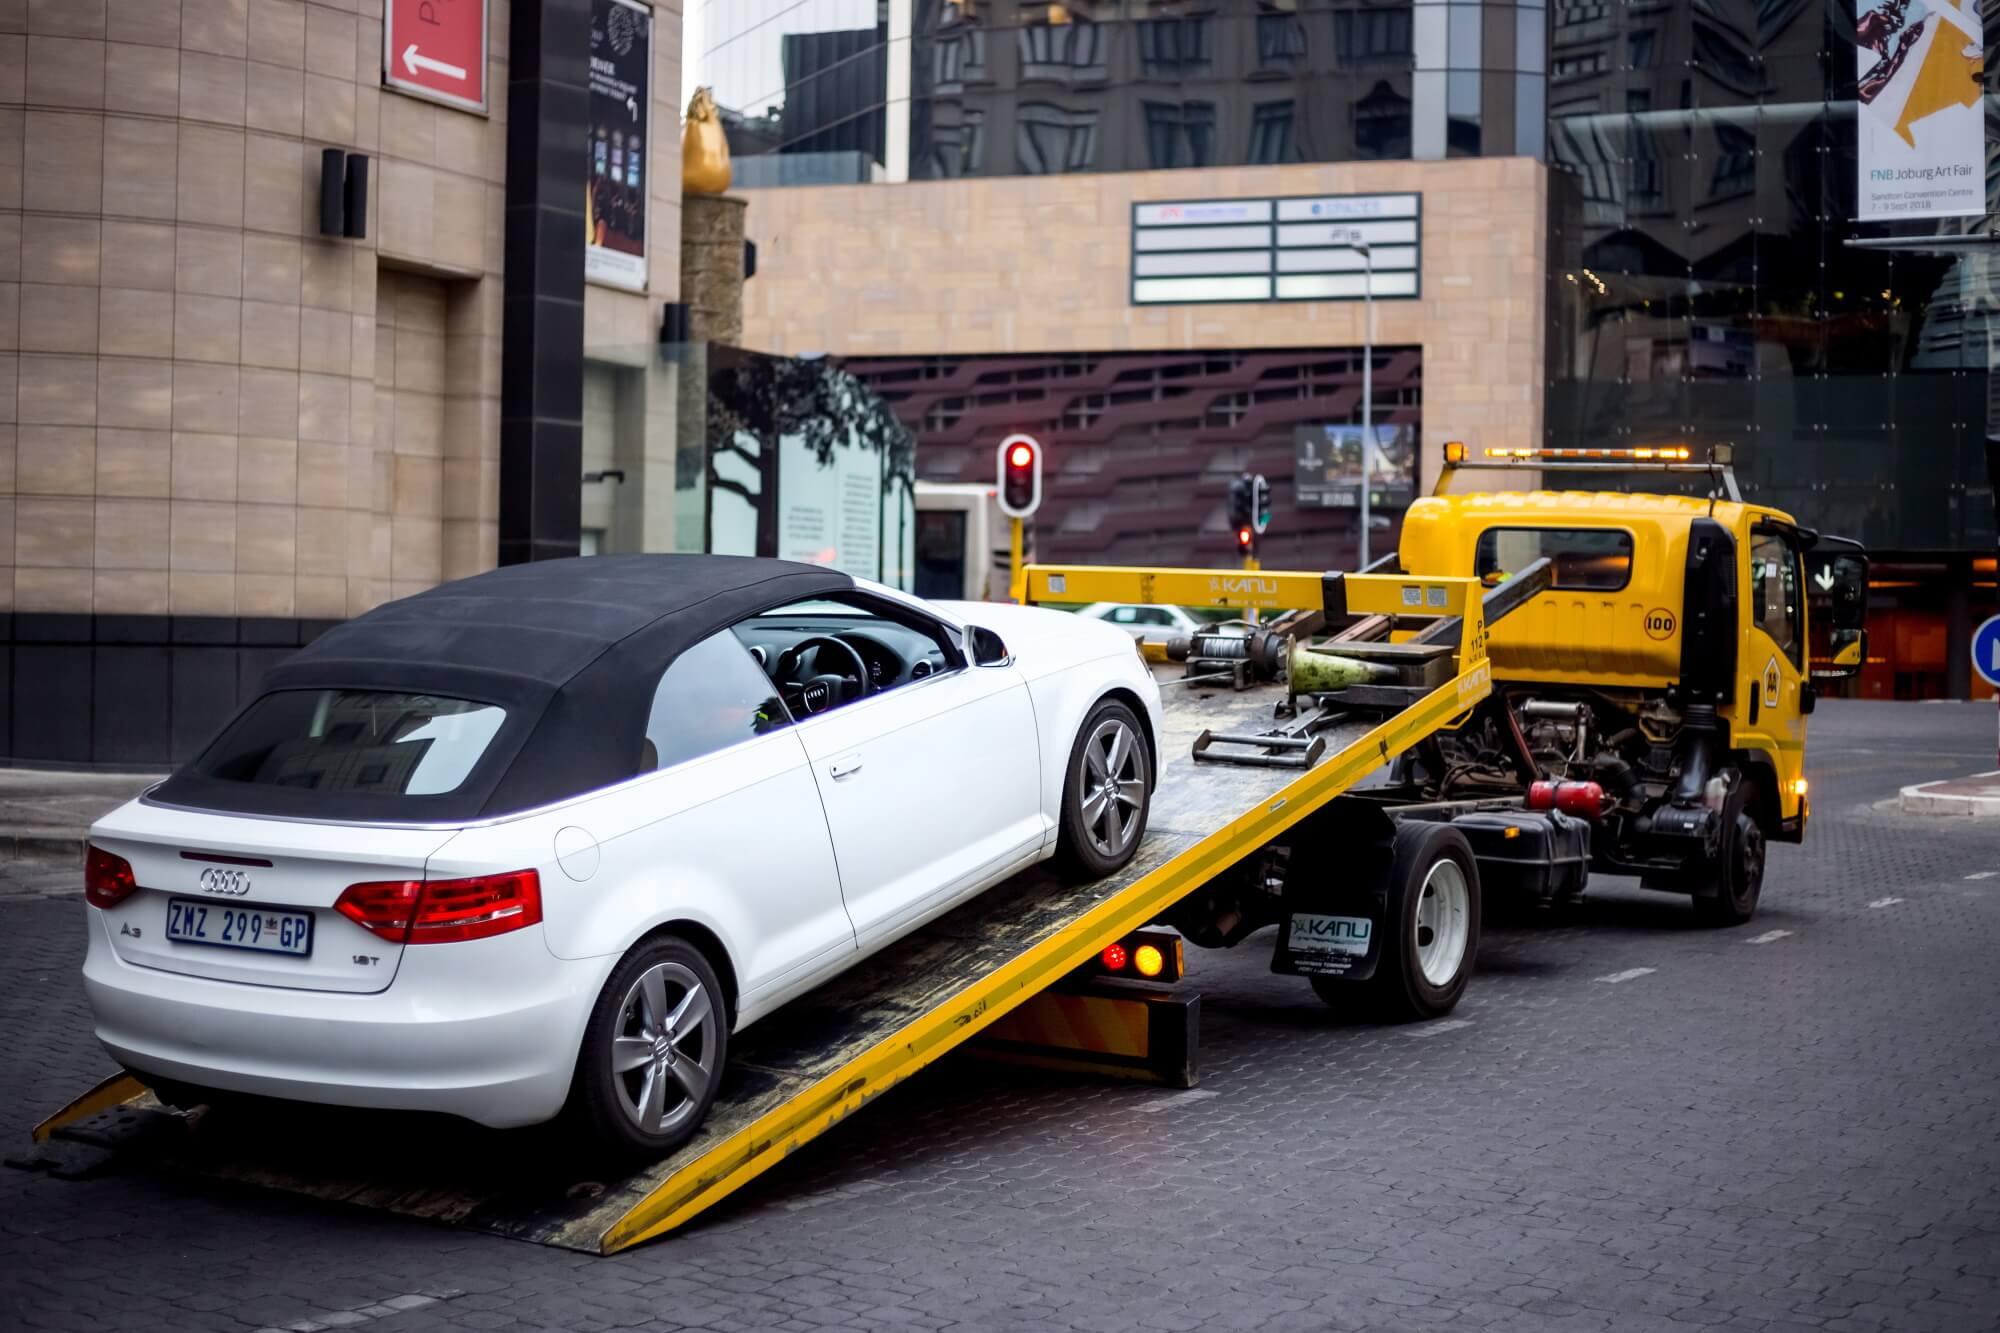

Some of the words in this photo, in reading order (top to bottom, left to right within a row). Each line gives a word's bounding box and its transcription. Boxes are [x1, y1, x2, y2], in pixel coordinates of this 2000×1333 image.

[1870, 169, 1894, 181] FNB
[1895, 167, 1934, 180] Joburg
[1935, 165, 1952, 177] Art
[1954, 164, 1973, 176] Fair
[1871, 192, 1902, 202] Sandton
[1904, 189, 1947, 200] Convention
[1948, 187, 1975, 197] Centre
[1891, 201, 1908, 210] Sept
[1909, 199, 1932, 210] 2018
[1647, 616, 1673, 632] 100
[120, 921, 142, 939] A3
[170, 904, 208, 938] ZMZ
[222, 910, 262, 944] 299
[280, 916, 306, 949] GP
[1309, 919, 1369, 938] KANU
